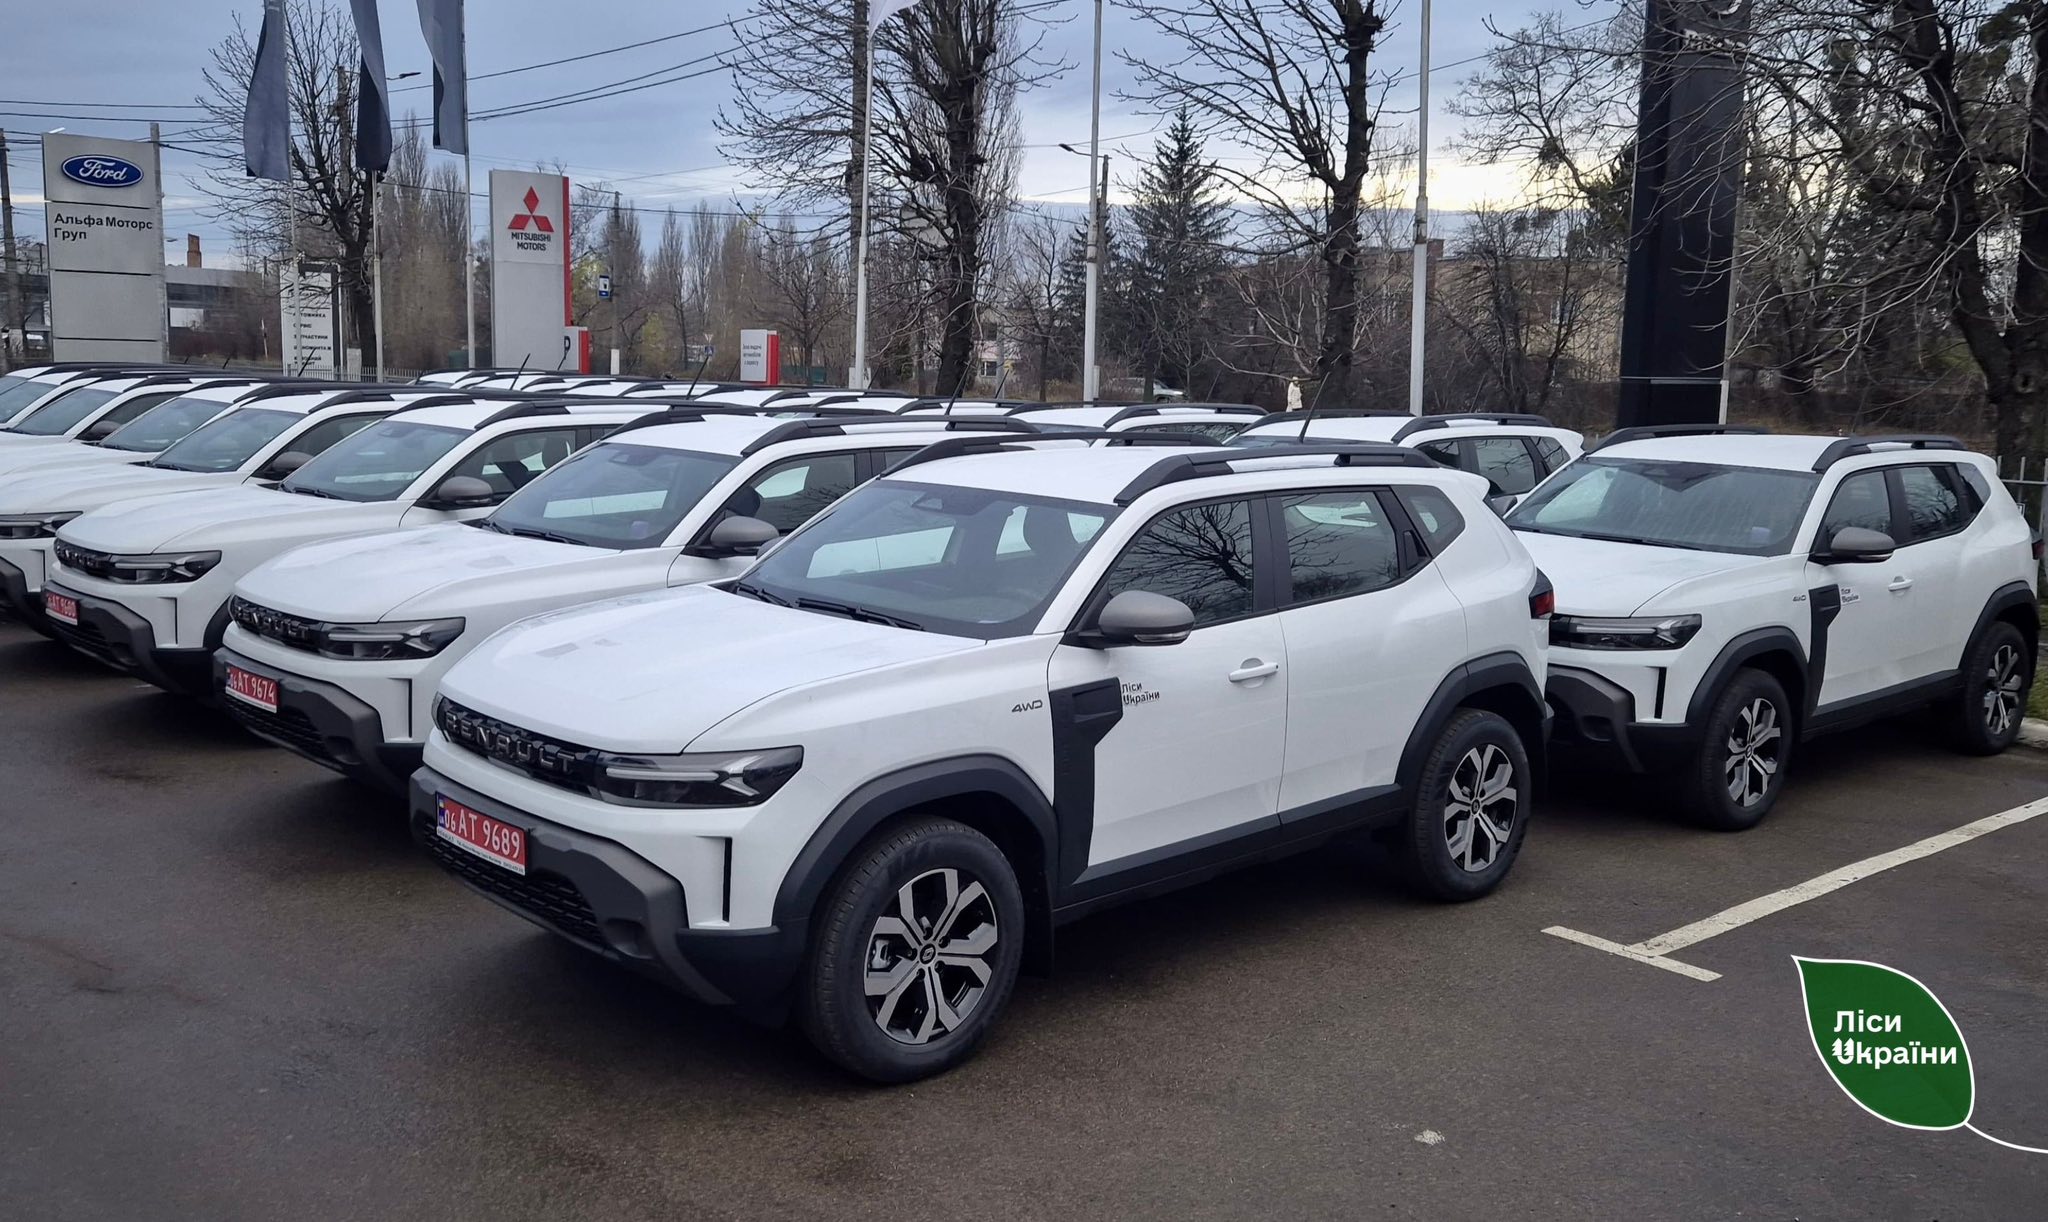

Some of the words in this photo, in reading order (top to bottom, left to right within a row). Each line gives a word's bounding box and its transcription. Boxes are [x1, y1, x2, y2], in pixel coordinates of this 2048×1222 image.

[79, 159, 128, 181] Ford
[54, 213, 103, 228] Альфа
[105, 216, 153, 231] Моторс
[54, 228, 87, 241] Груп
[511, 232, 551, 242] MITSUBISHI
[517, 241, 546, 251] MOTORS
[251, 677, 275, 703] 9674
[1122, 682, 1142, 694] Ліси
[1011, 699, 1043, 713] 4WD
[446, 711, 575, 773] RENAULT
[483, 820, 520, 859] 9689
